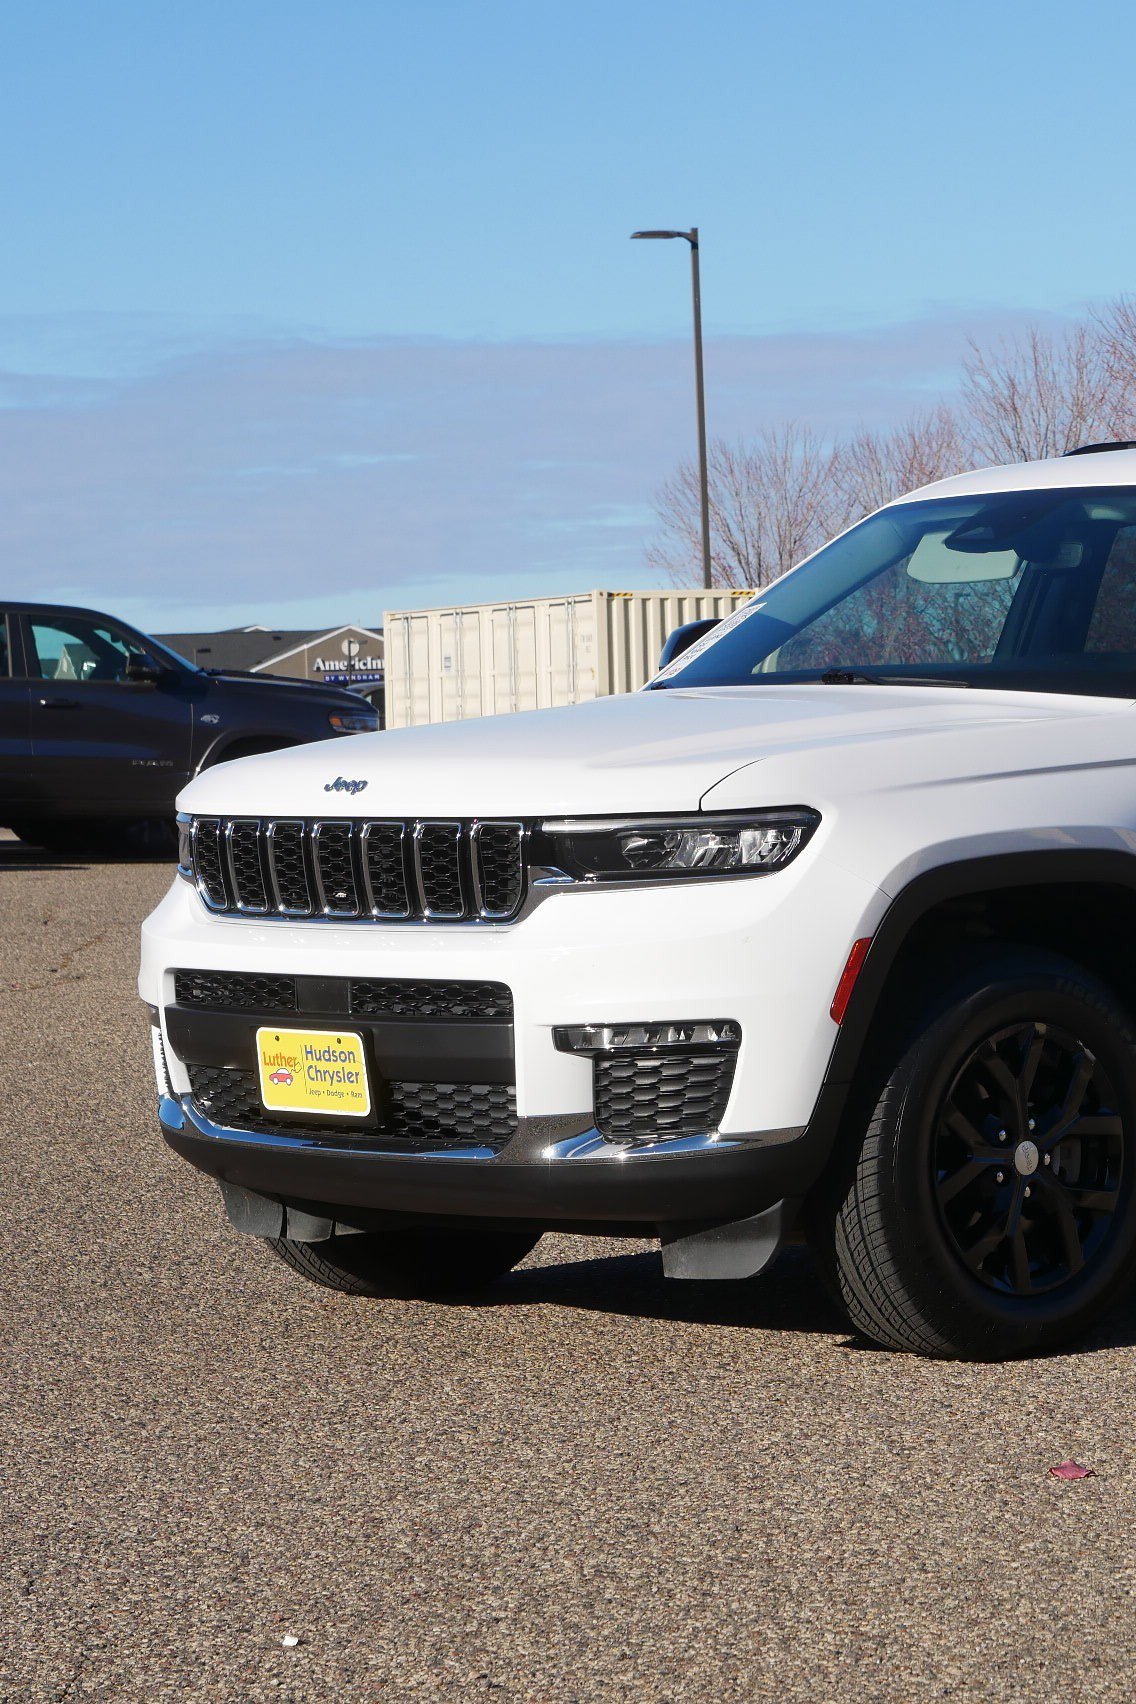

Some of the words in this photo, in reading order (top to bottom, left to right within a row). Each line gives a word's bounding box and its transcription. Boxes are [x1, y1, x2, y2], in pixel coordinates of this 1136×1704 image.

[313, 656, 385, 671] AmeicIn
[324, 776, 368, 795] Jeep
[262, 1051, 298, 1068] Luther
[304, 1044, 356, 1064] Hudson
[306, 1064, 360, 1086] Chrysler
[309, 1088, 321, 1097] Jeep
[326, 1089, 344, 1098] Dodge
